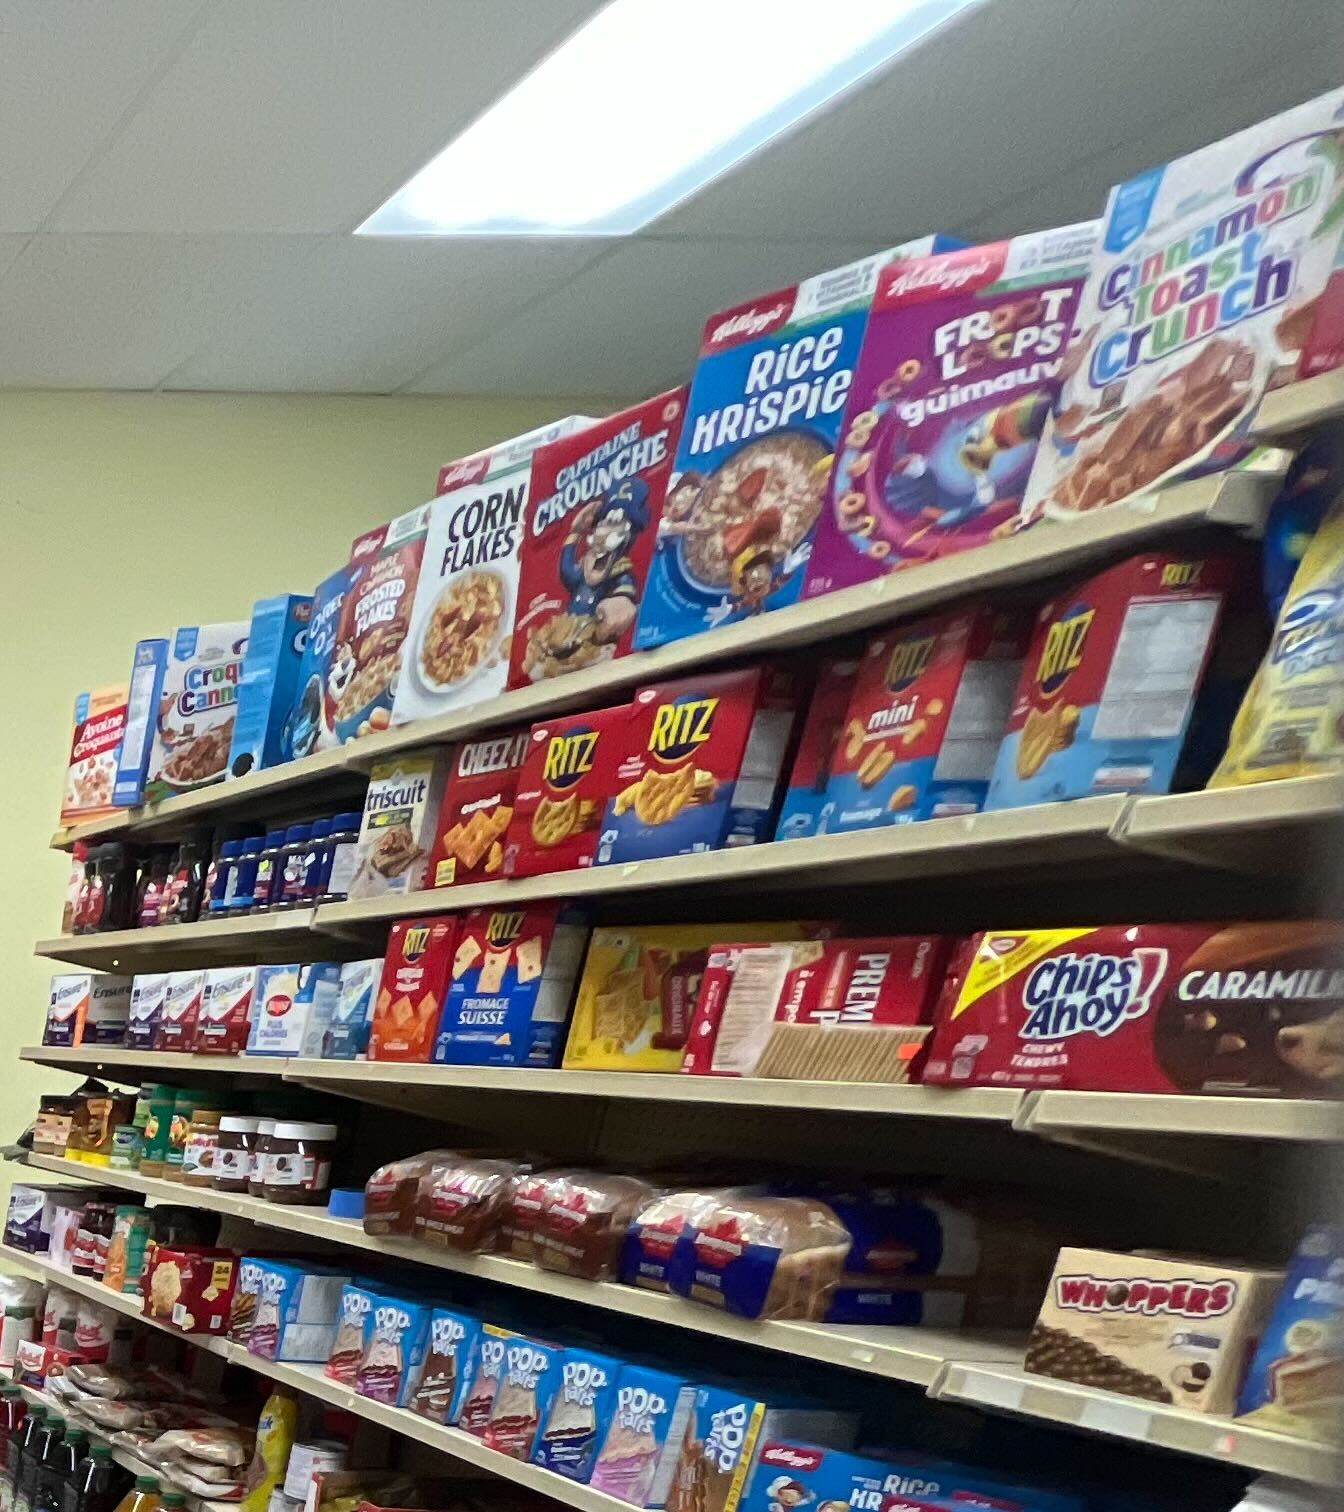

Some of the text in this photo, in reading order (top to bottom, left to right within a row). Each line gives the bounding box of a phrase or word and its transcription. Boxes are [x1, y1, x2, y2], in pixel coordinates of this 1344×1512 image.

[555, 420, 642, 491] CAPITAINE
[531, 429, 670, 537] CROUNCHE
[448, 481, 527, 544] CORN
[440, 525, 518, 577] FLAKES
[354, 578, 406, 621] FROSTED
[885, 634, 938, 686] RITZ
[1035, 607, 1096, 684] RITZ
[179, 684, 239, 715] Cann
[186, 662, 241, 691] Croq
[648, 697, 721, 753] RITZ
[867, 694, 920, 730] mini
[542, 731, 601, 780] RITZ
[366, 779, 427, 812] triscuit
[401, 927, 431, 955] RITZ
[485, 911, 528, 942] RITZ
[460, 997, 511, 1011] FROMAGE
[838, 952, 892, 1023] PREM
[1025, 953, 1140, 1007] Chips
[457, 1010, 509, 1026] SUISSE
